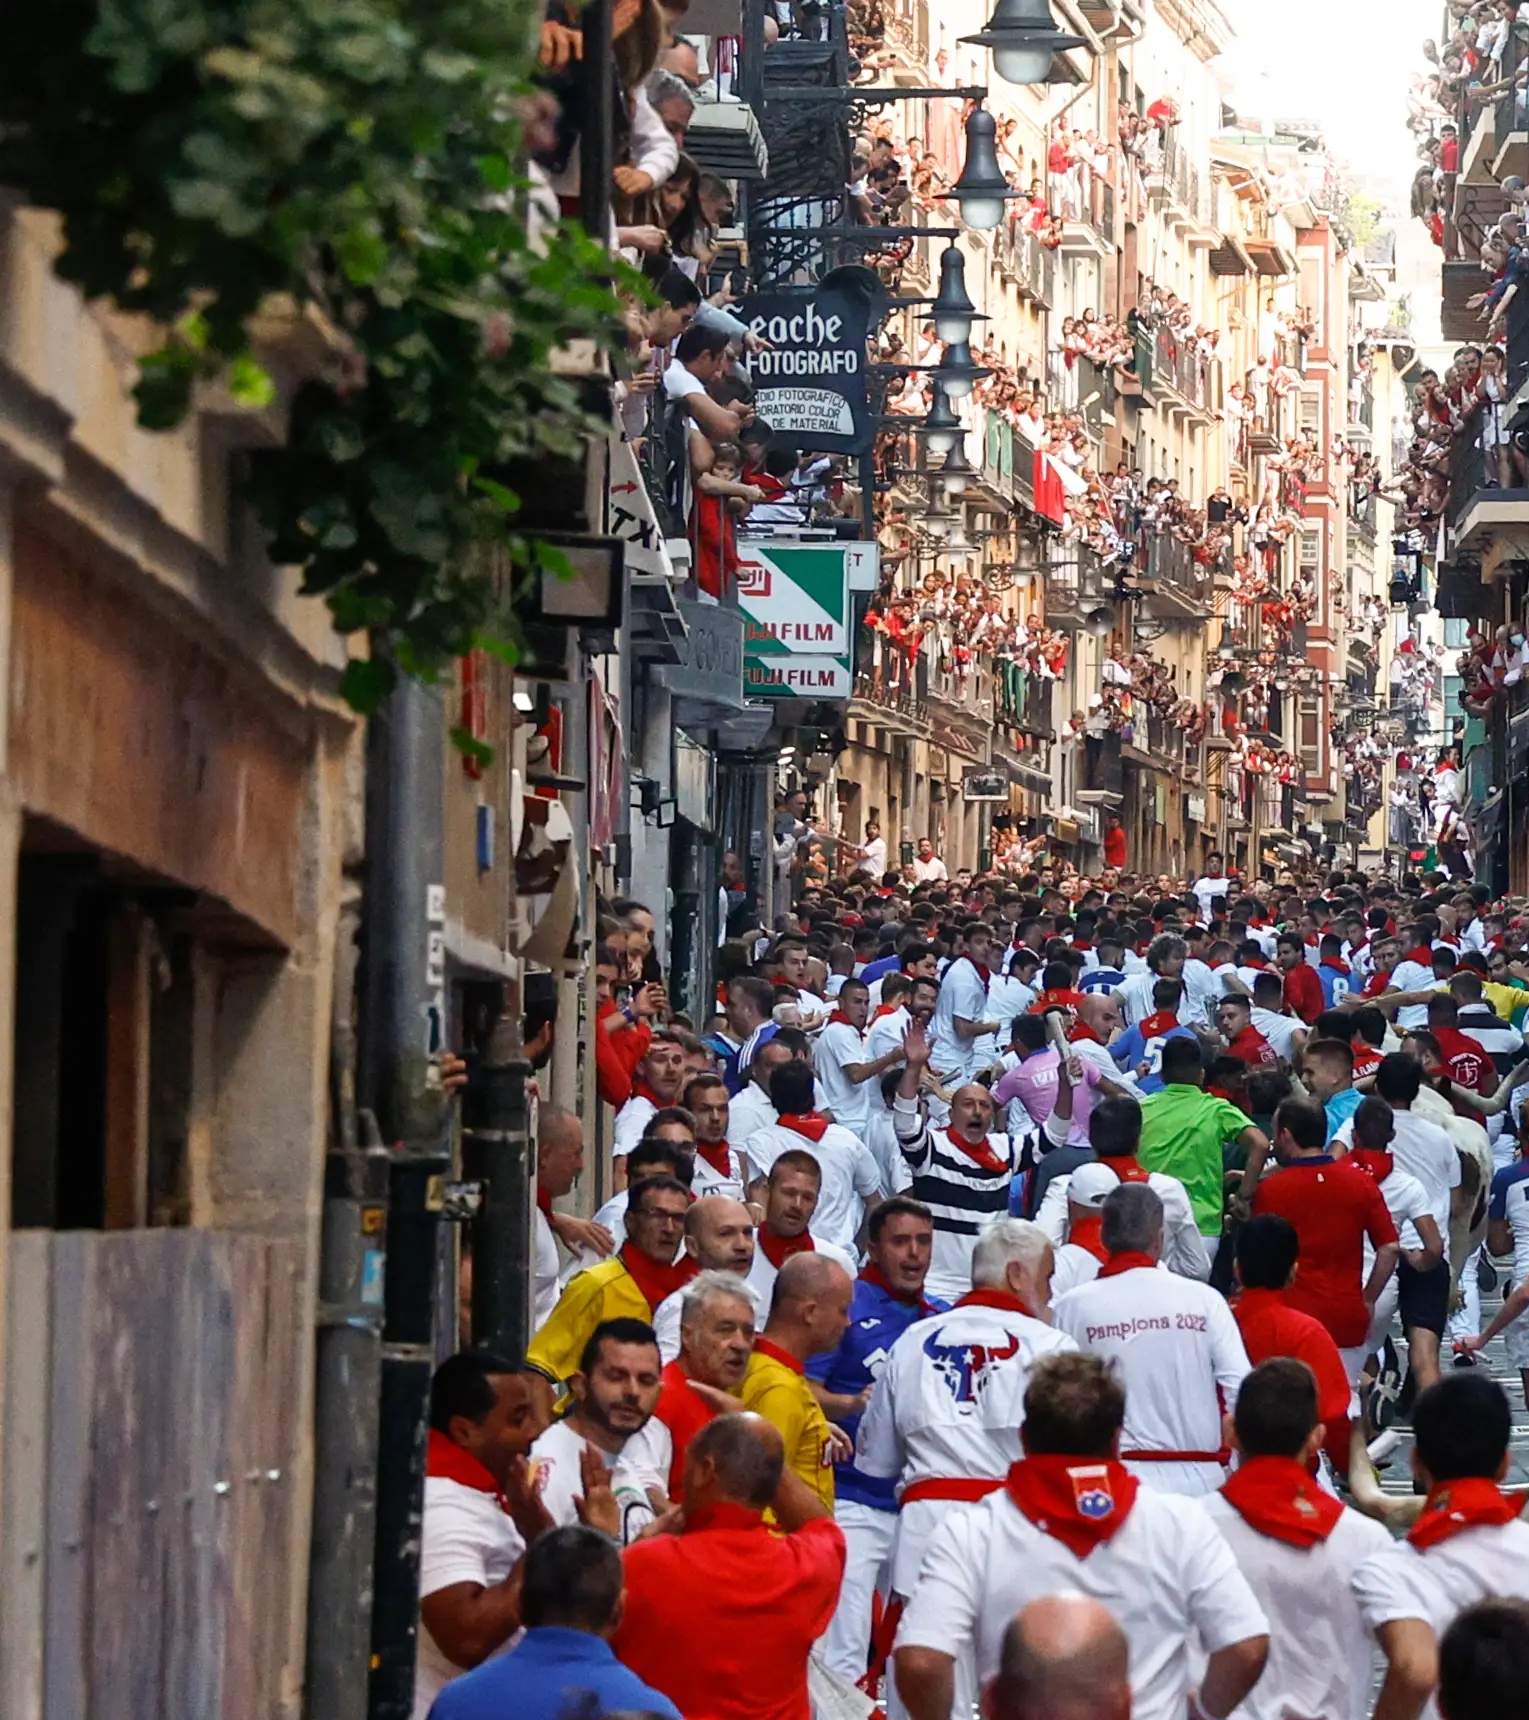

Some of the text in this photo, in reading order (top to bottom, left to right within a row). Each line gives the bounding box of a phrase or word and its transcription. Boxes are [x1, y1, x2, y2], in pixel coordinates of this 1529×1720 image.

[722, 302, 842, 348] eache
[745, 349, 858, 375] FOTOGRAFO
[808, 404, 841, 419] COLOR
[772, 417, 842, 432] DE MATERIAL
[1144, 1036, 1168, 1075] 5
[1175, 1313, 1207, 1332] 2022
